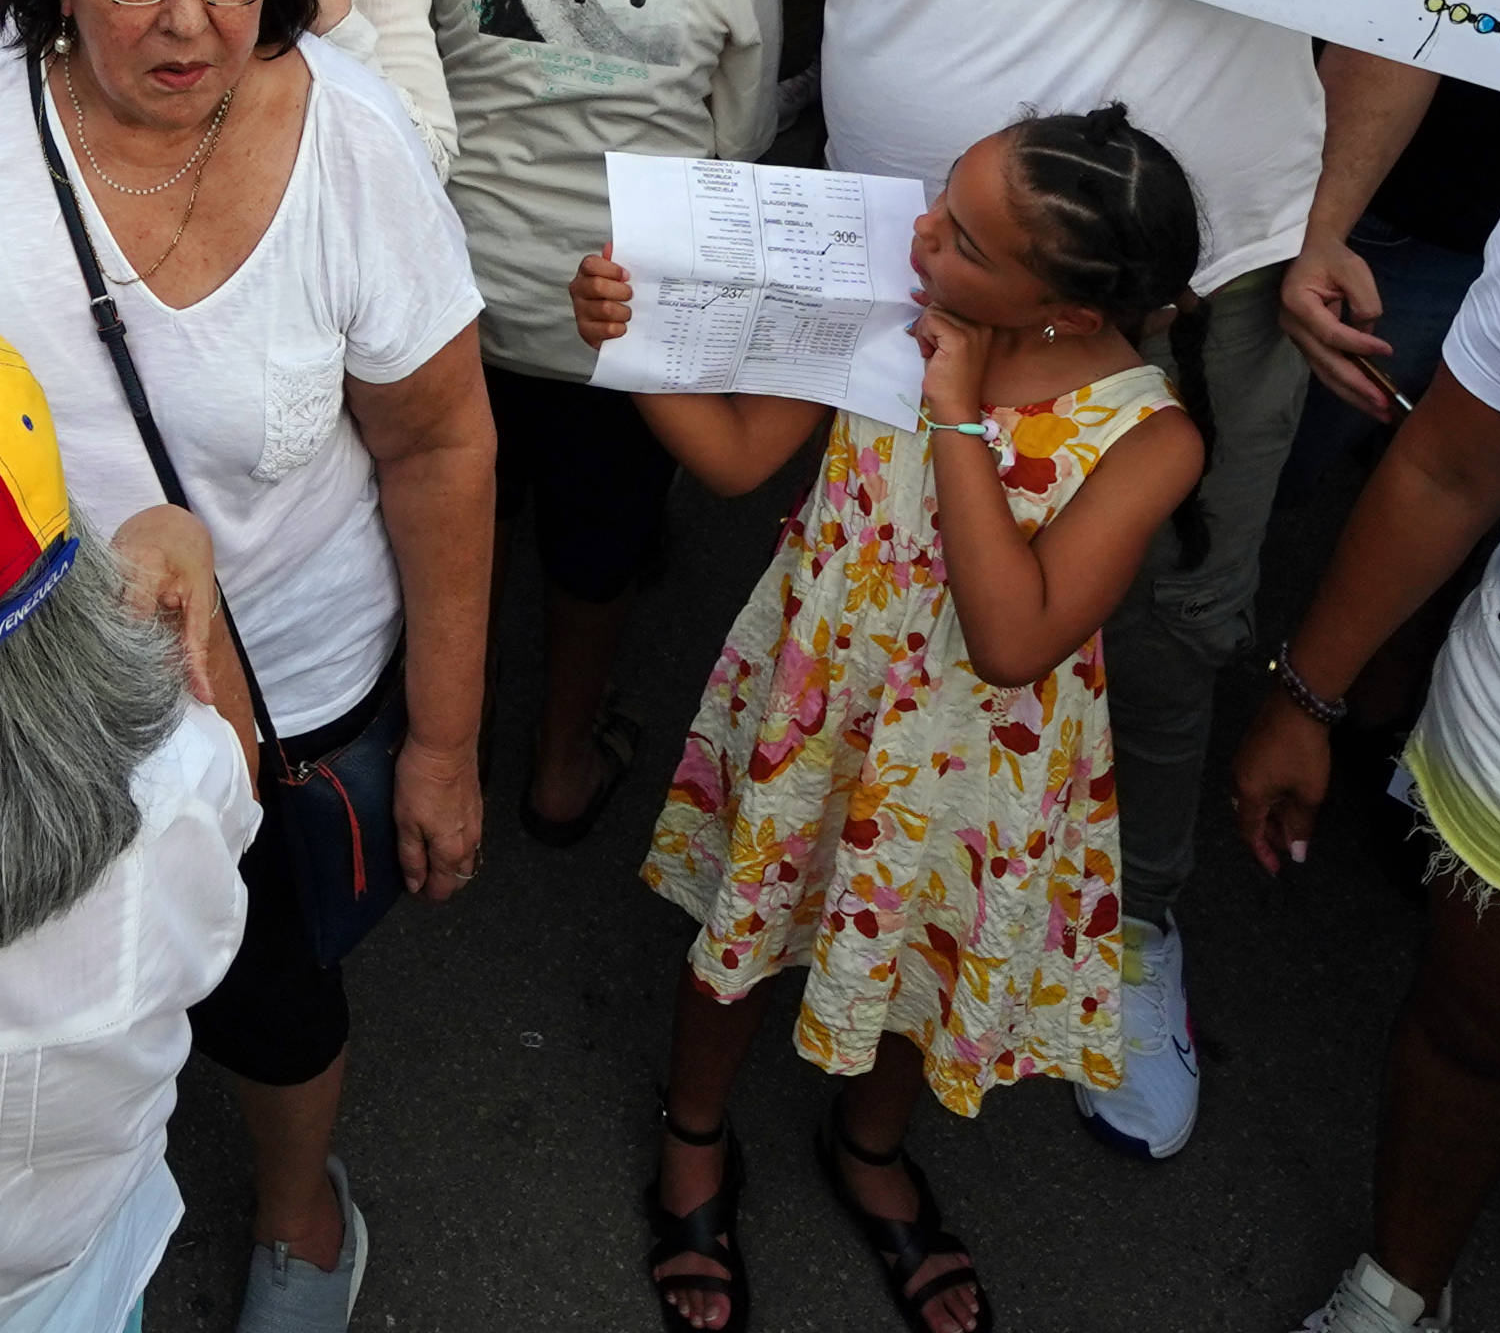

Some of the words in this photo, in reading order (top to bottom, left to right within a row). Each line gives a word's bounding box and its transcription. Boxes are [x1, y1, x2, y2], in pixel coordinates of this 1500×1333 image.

[567, 54, 592, 68] FOR
[594, 62, 650, 81] ENDLESS
[833, 230, 857, 244] 300
[721, 286, 745, 300] 237
